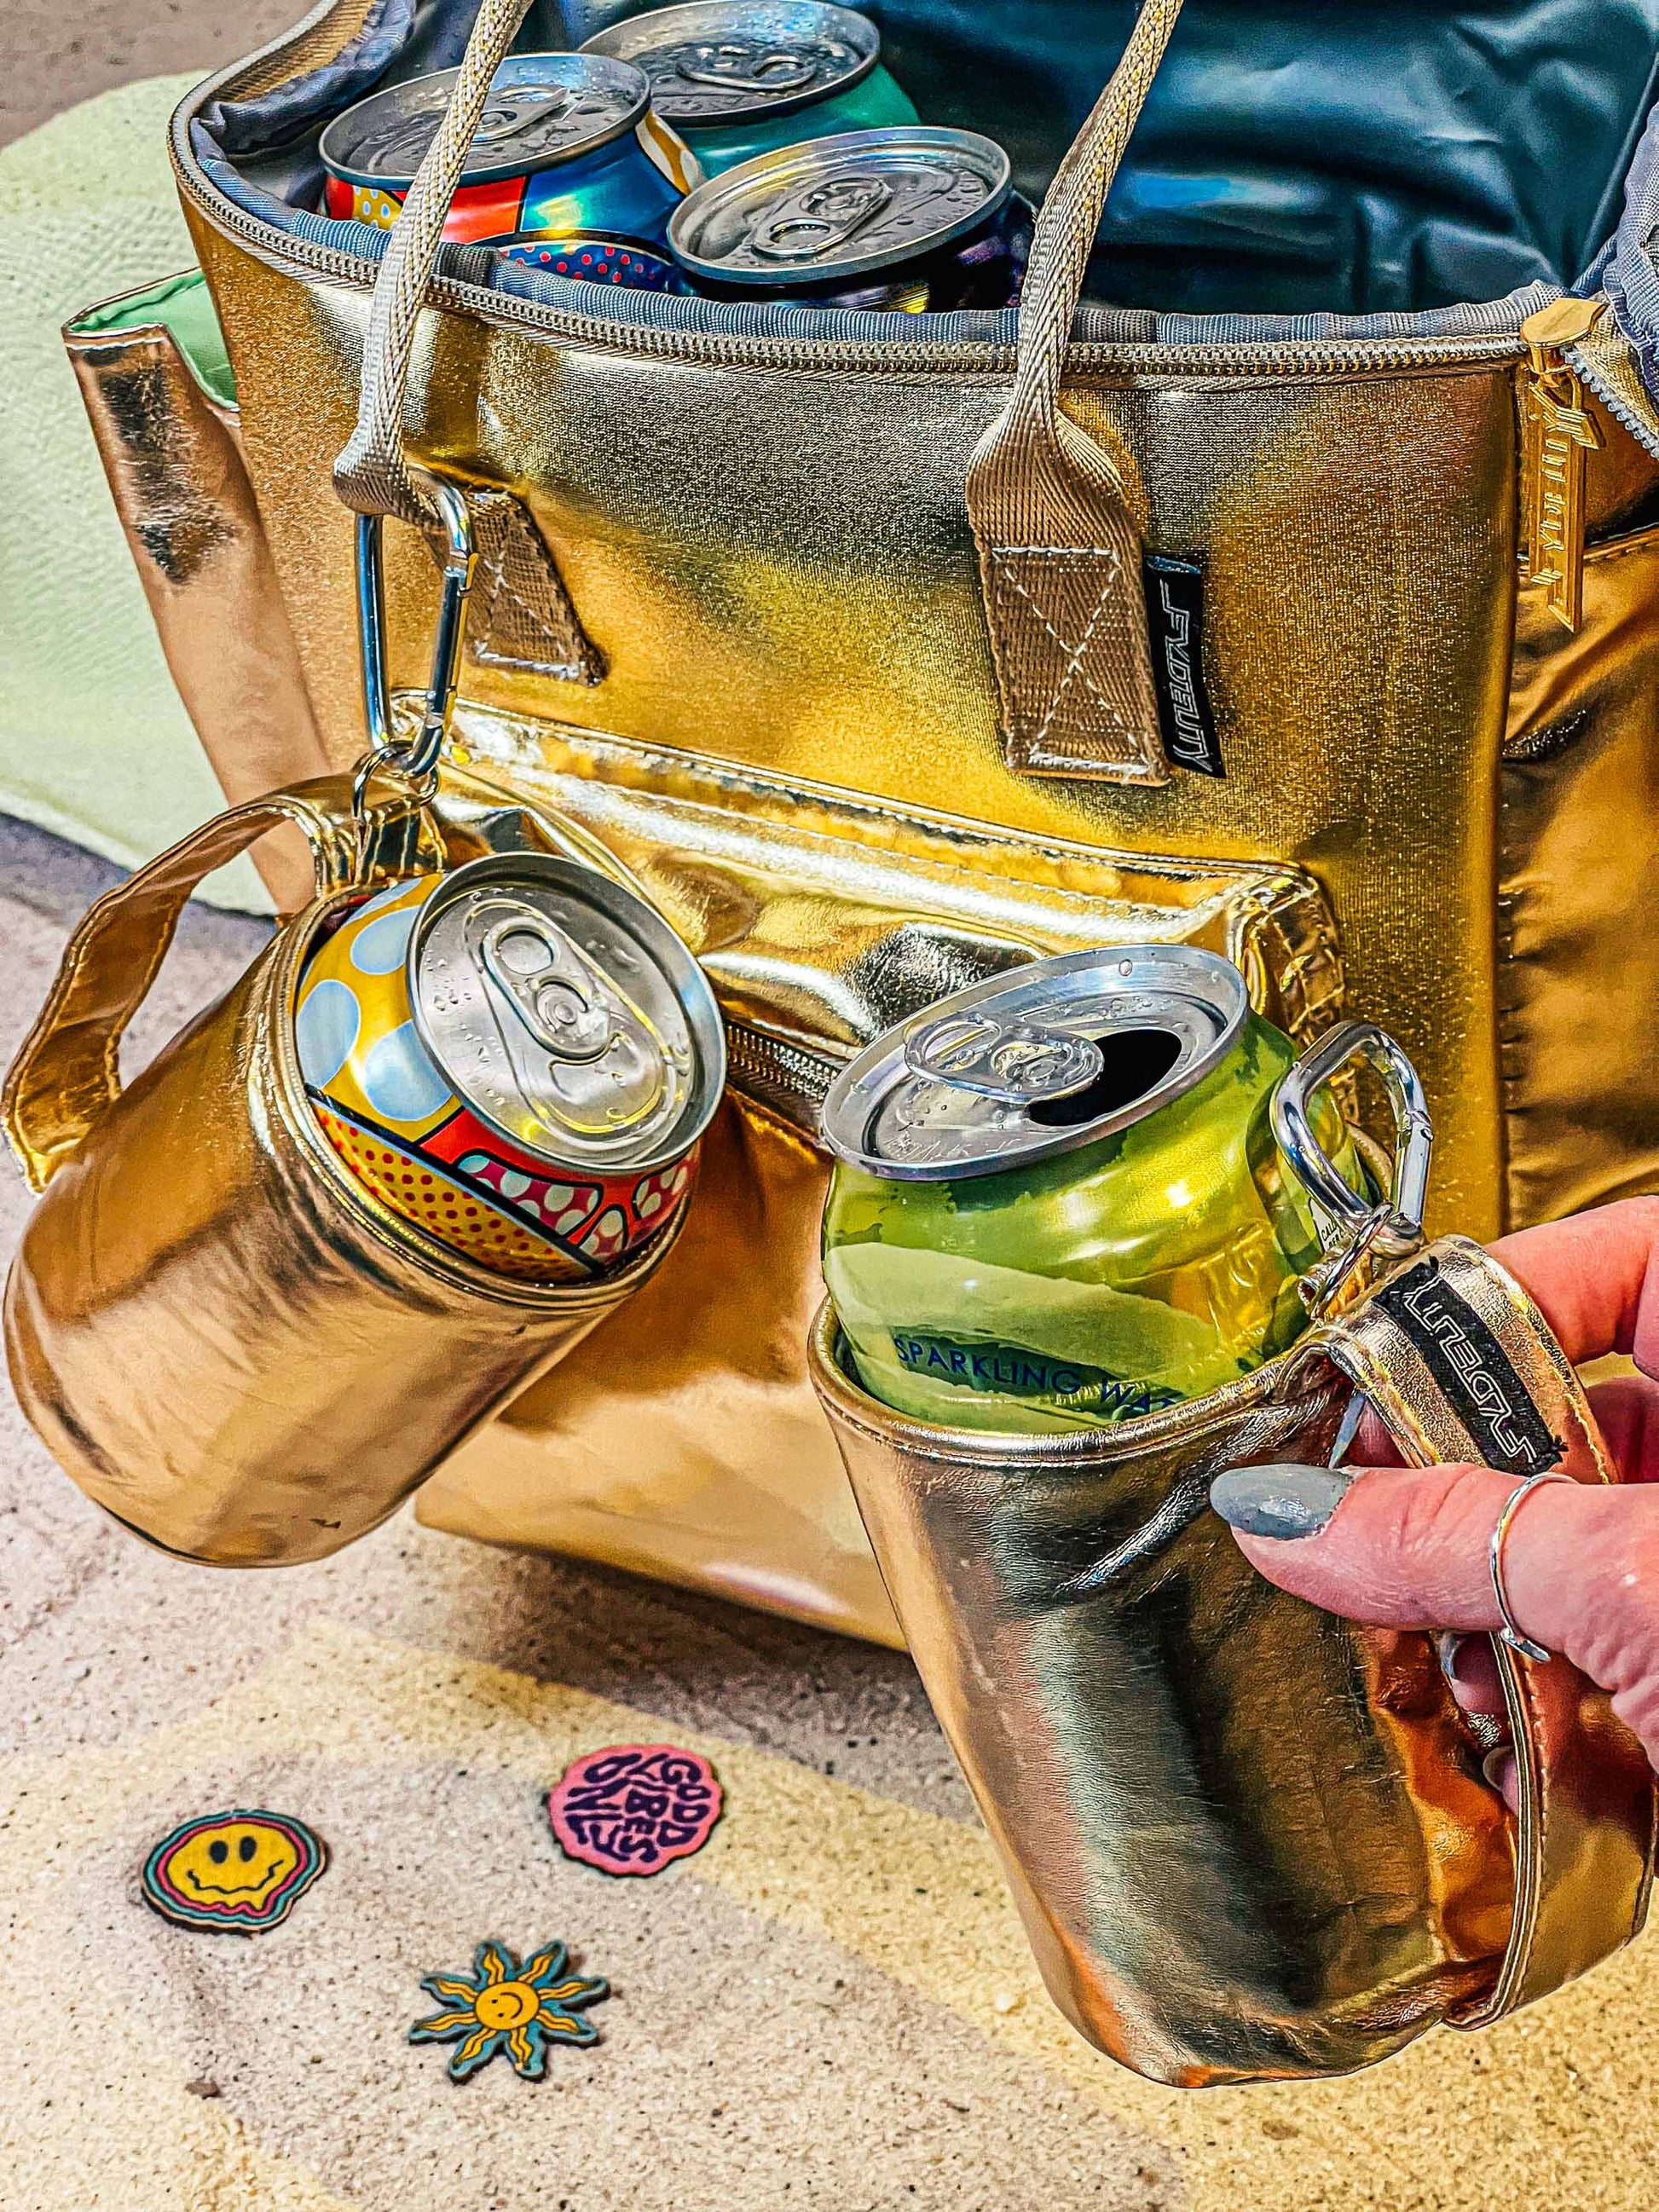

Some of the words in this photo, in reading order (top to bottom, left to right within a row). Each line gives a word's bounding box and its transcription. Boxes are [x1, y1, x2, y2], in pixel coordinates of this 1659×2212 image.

[1160, 579, 1213, 773] FYDELITY
[893, 1337, 1081, 1395] SPARKLING
[1391, 1275, 1537, 1464] FYDELITY
[563, 1753, 643, 1862] ONLY
[619, 1753, 676, 1863] VIBES
[656, 1759, 711, 1847] GOOD
